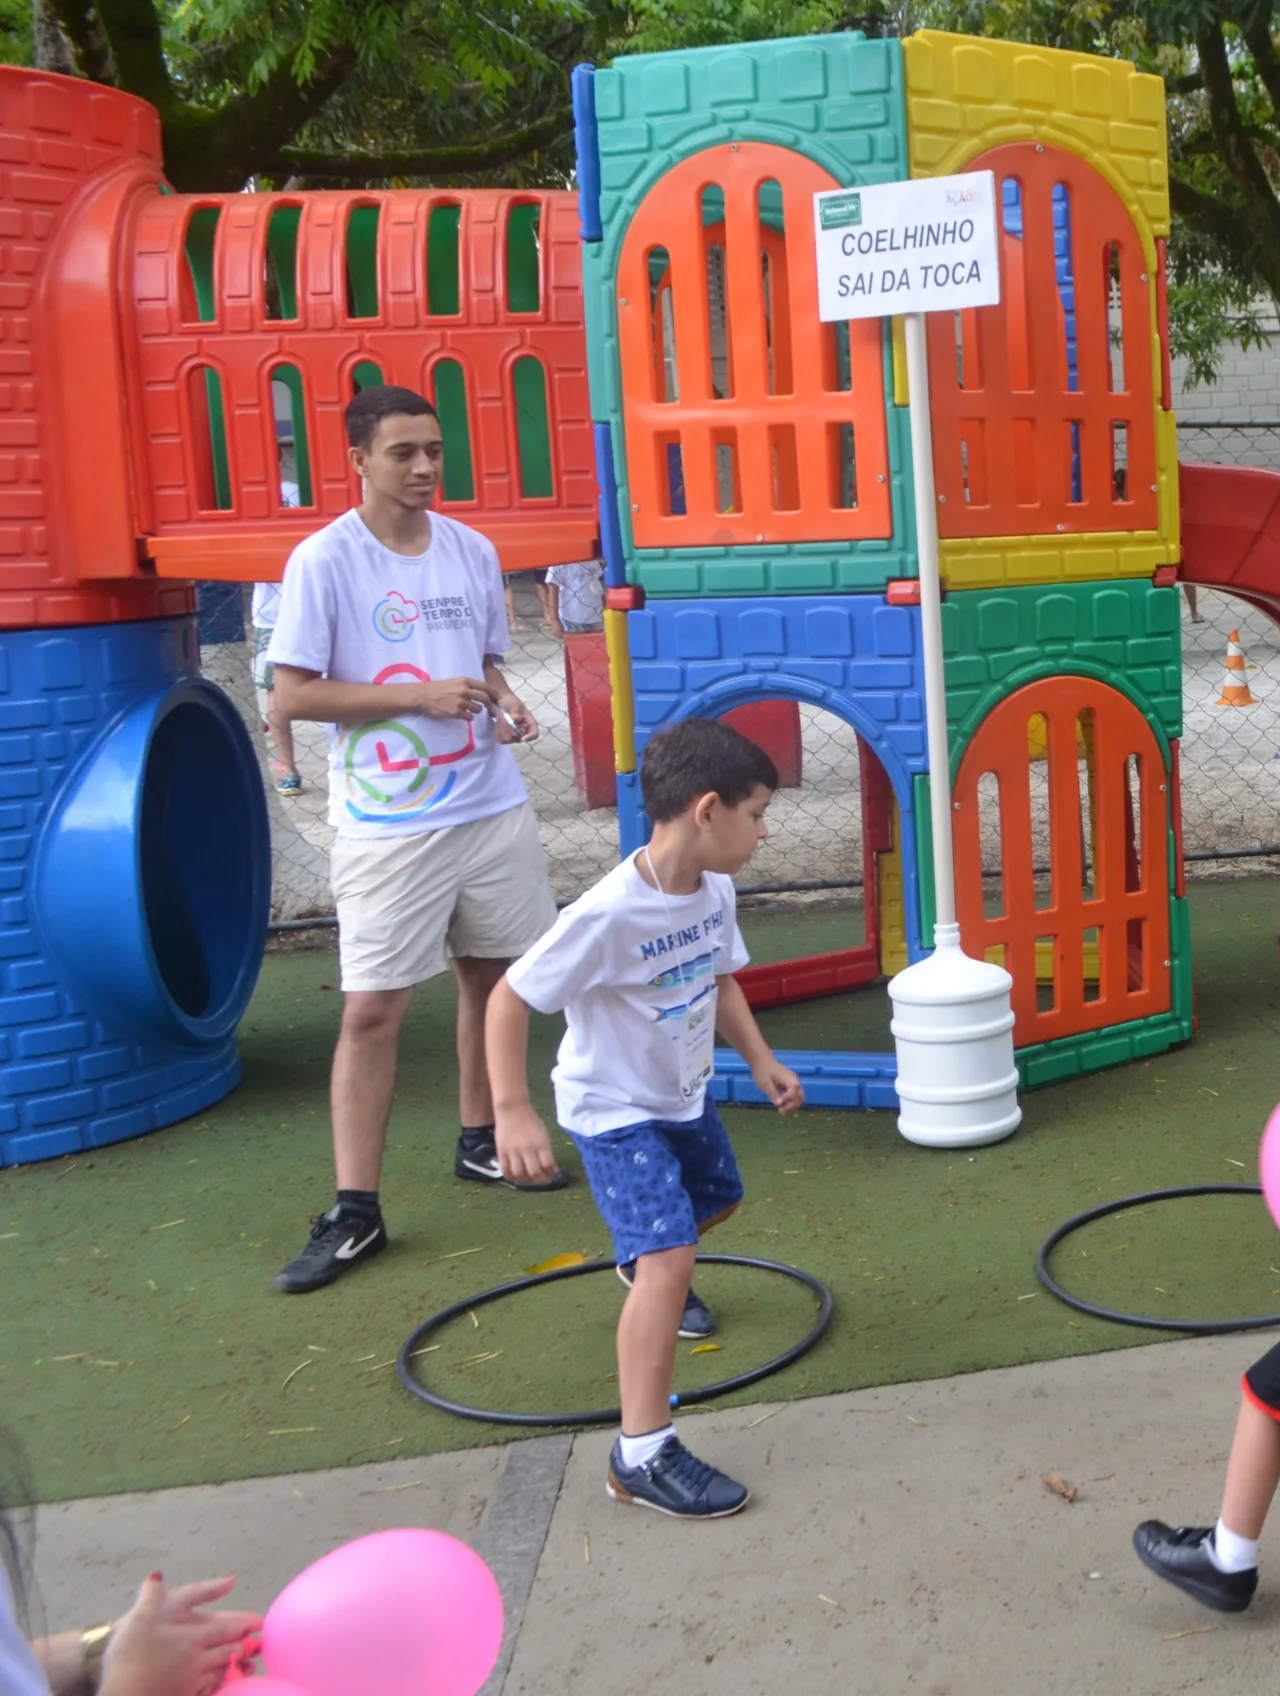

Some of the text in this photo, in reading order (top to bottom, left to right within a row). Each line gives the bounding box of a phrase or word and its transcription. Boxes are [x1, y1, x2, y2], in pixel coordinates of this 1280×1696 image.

[841, 219, 975, 257] COELHINHO
[837, 260, 981, 297] SAI DA TOCA
